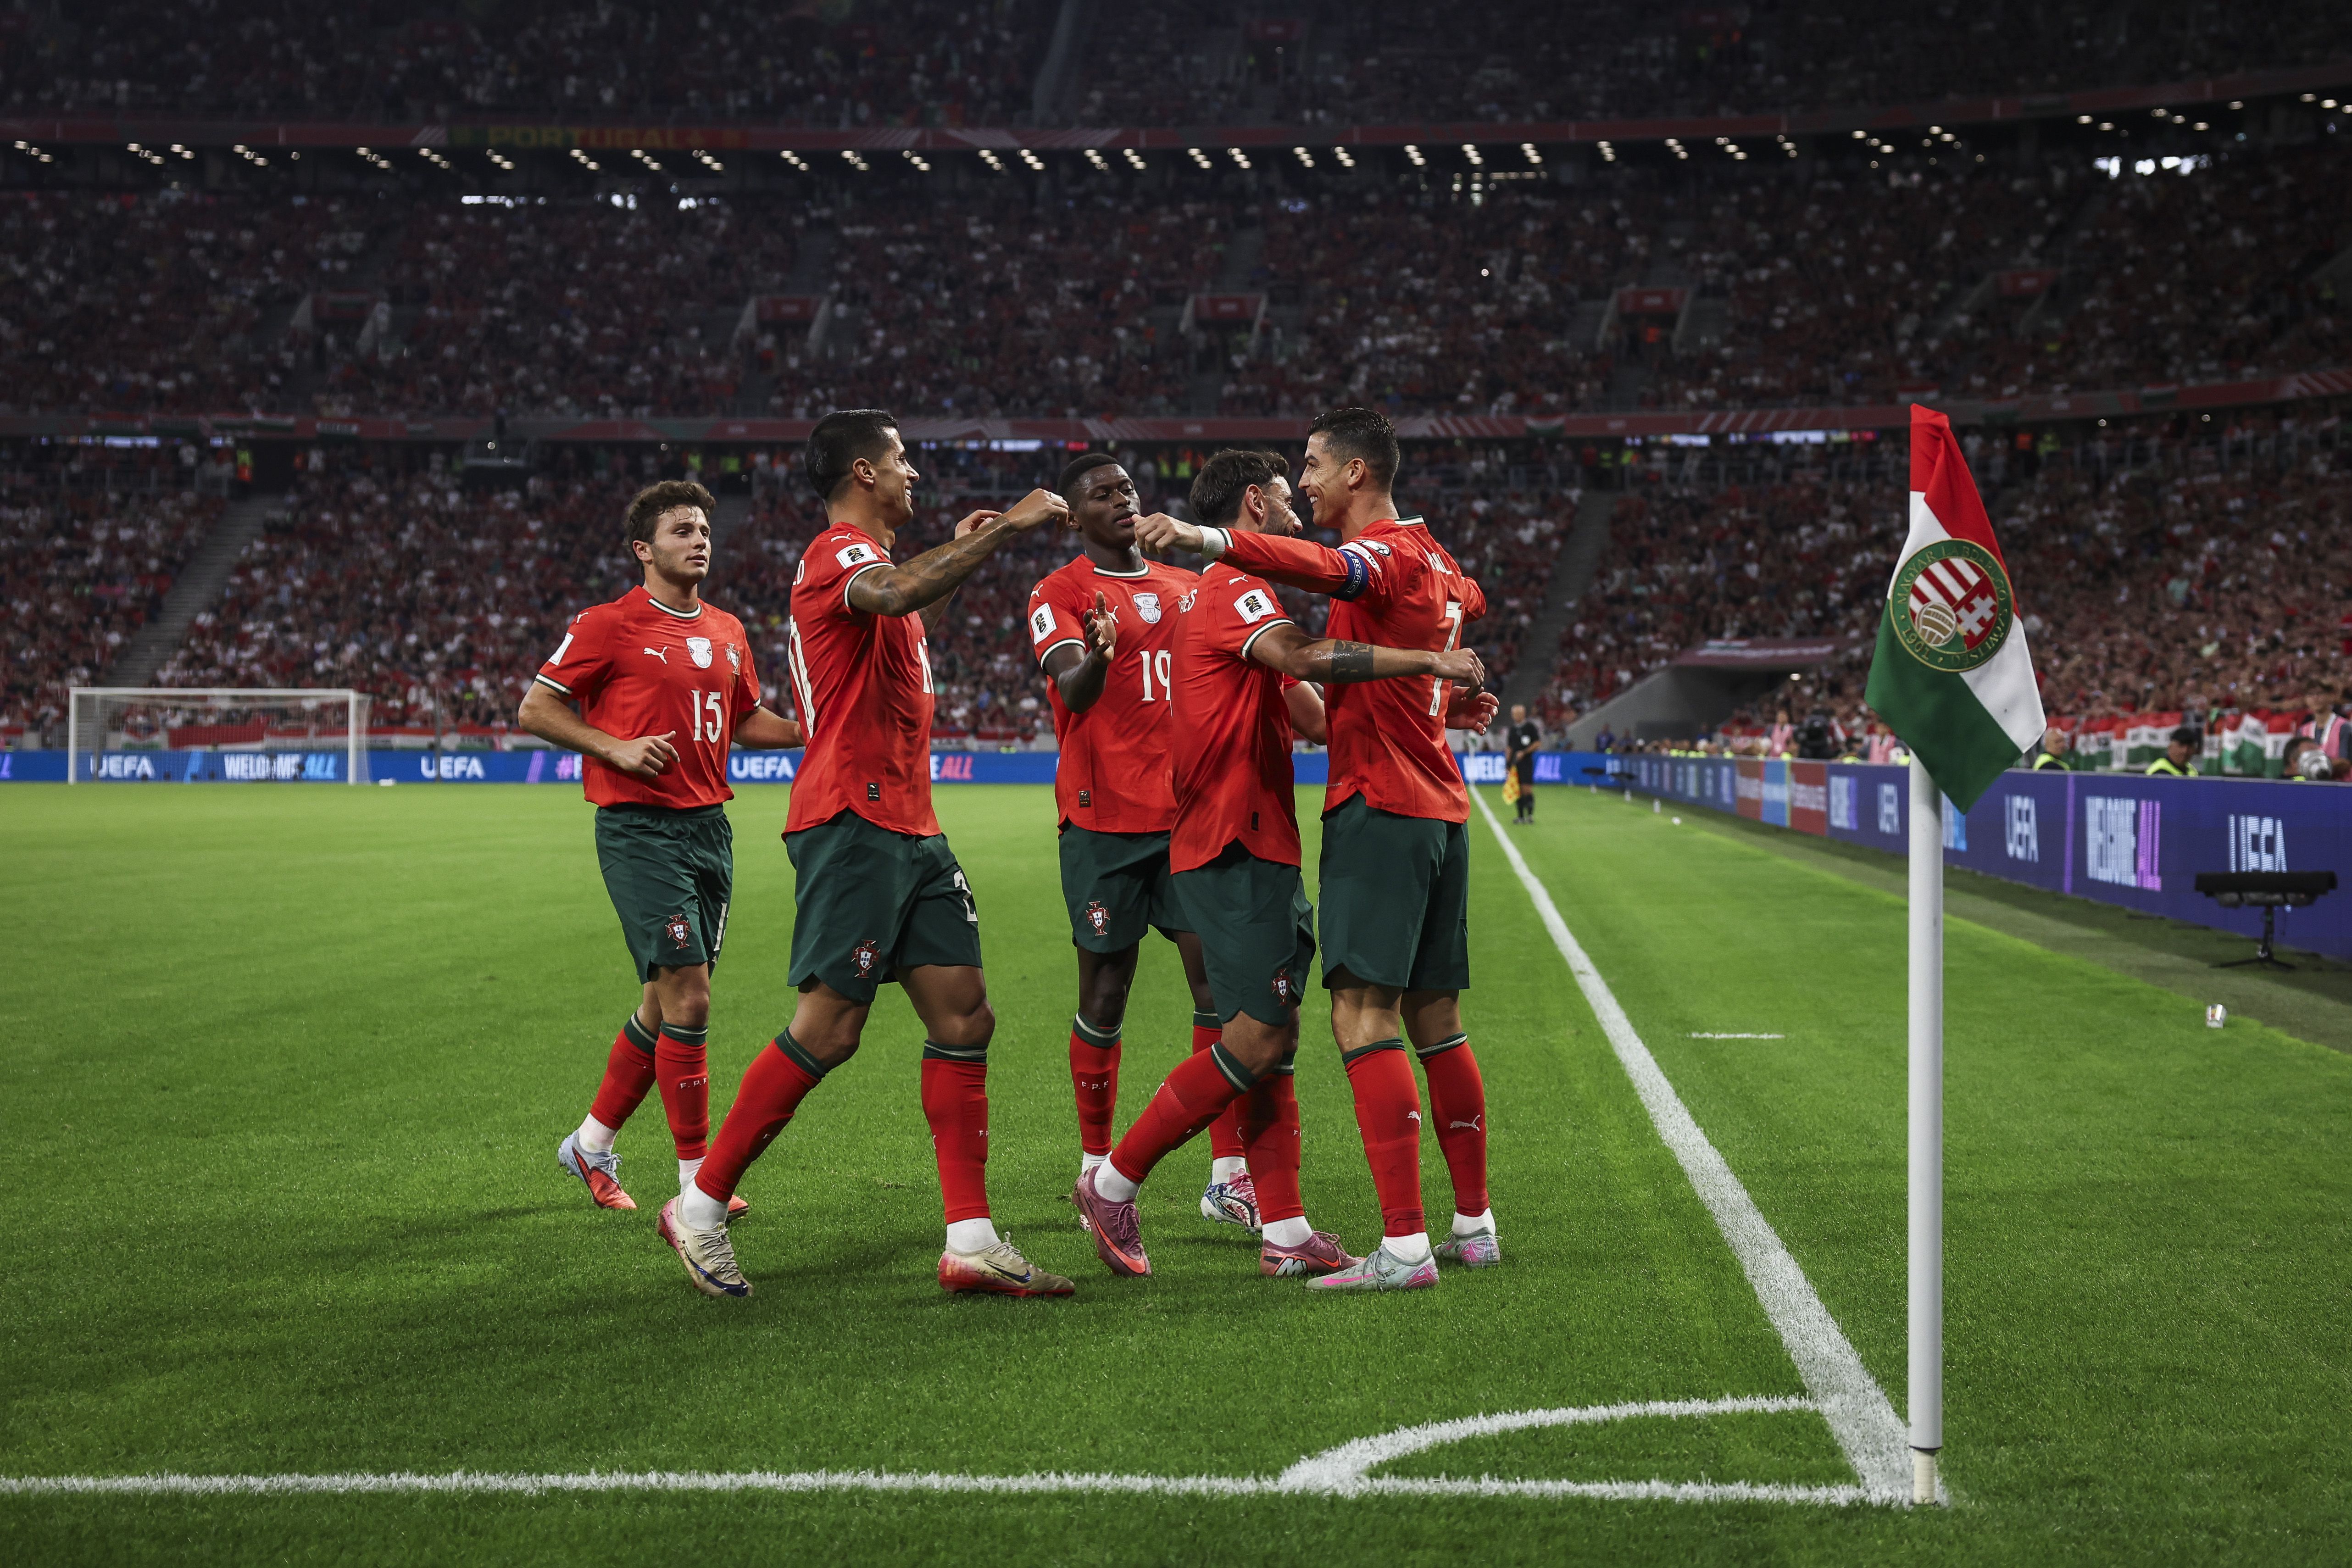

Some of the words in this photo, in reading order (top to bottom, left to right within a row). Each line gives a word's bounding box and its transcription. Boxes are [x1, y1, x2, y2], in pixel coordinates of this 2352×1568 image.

[1140, 650, 1171, 701] 19
[1429, 601, 1462, 716] 7
[691, 690, 723, 743] 15
[301, 753, 337, 779] ALL
[421, 756, 485, 779] UEFA
[731, 756, 795, 778] UEFA
[940, 756, 973, 780] ALL
[2004, 794, 2039, 863] UEFA
